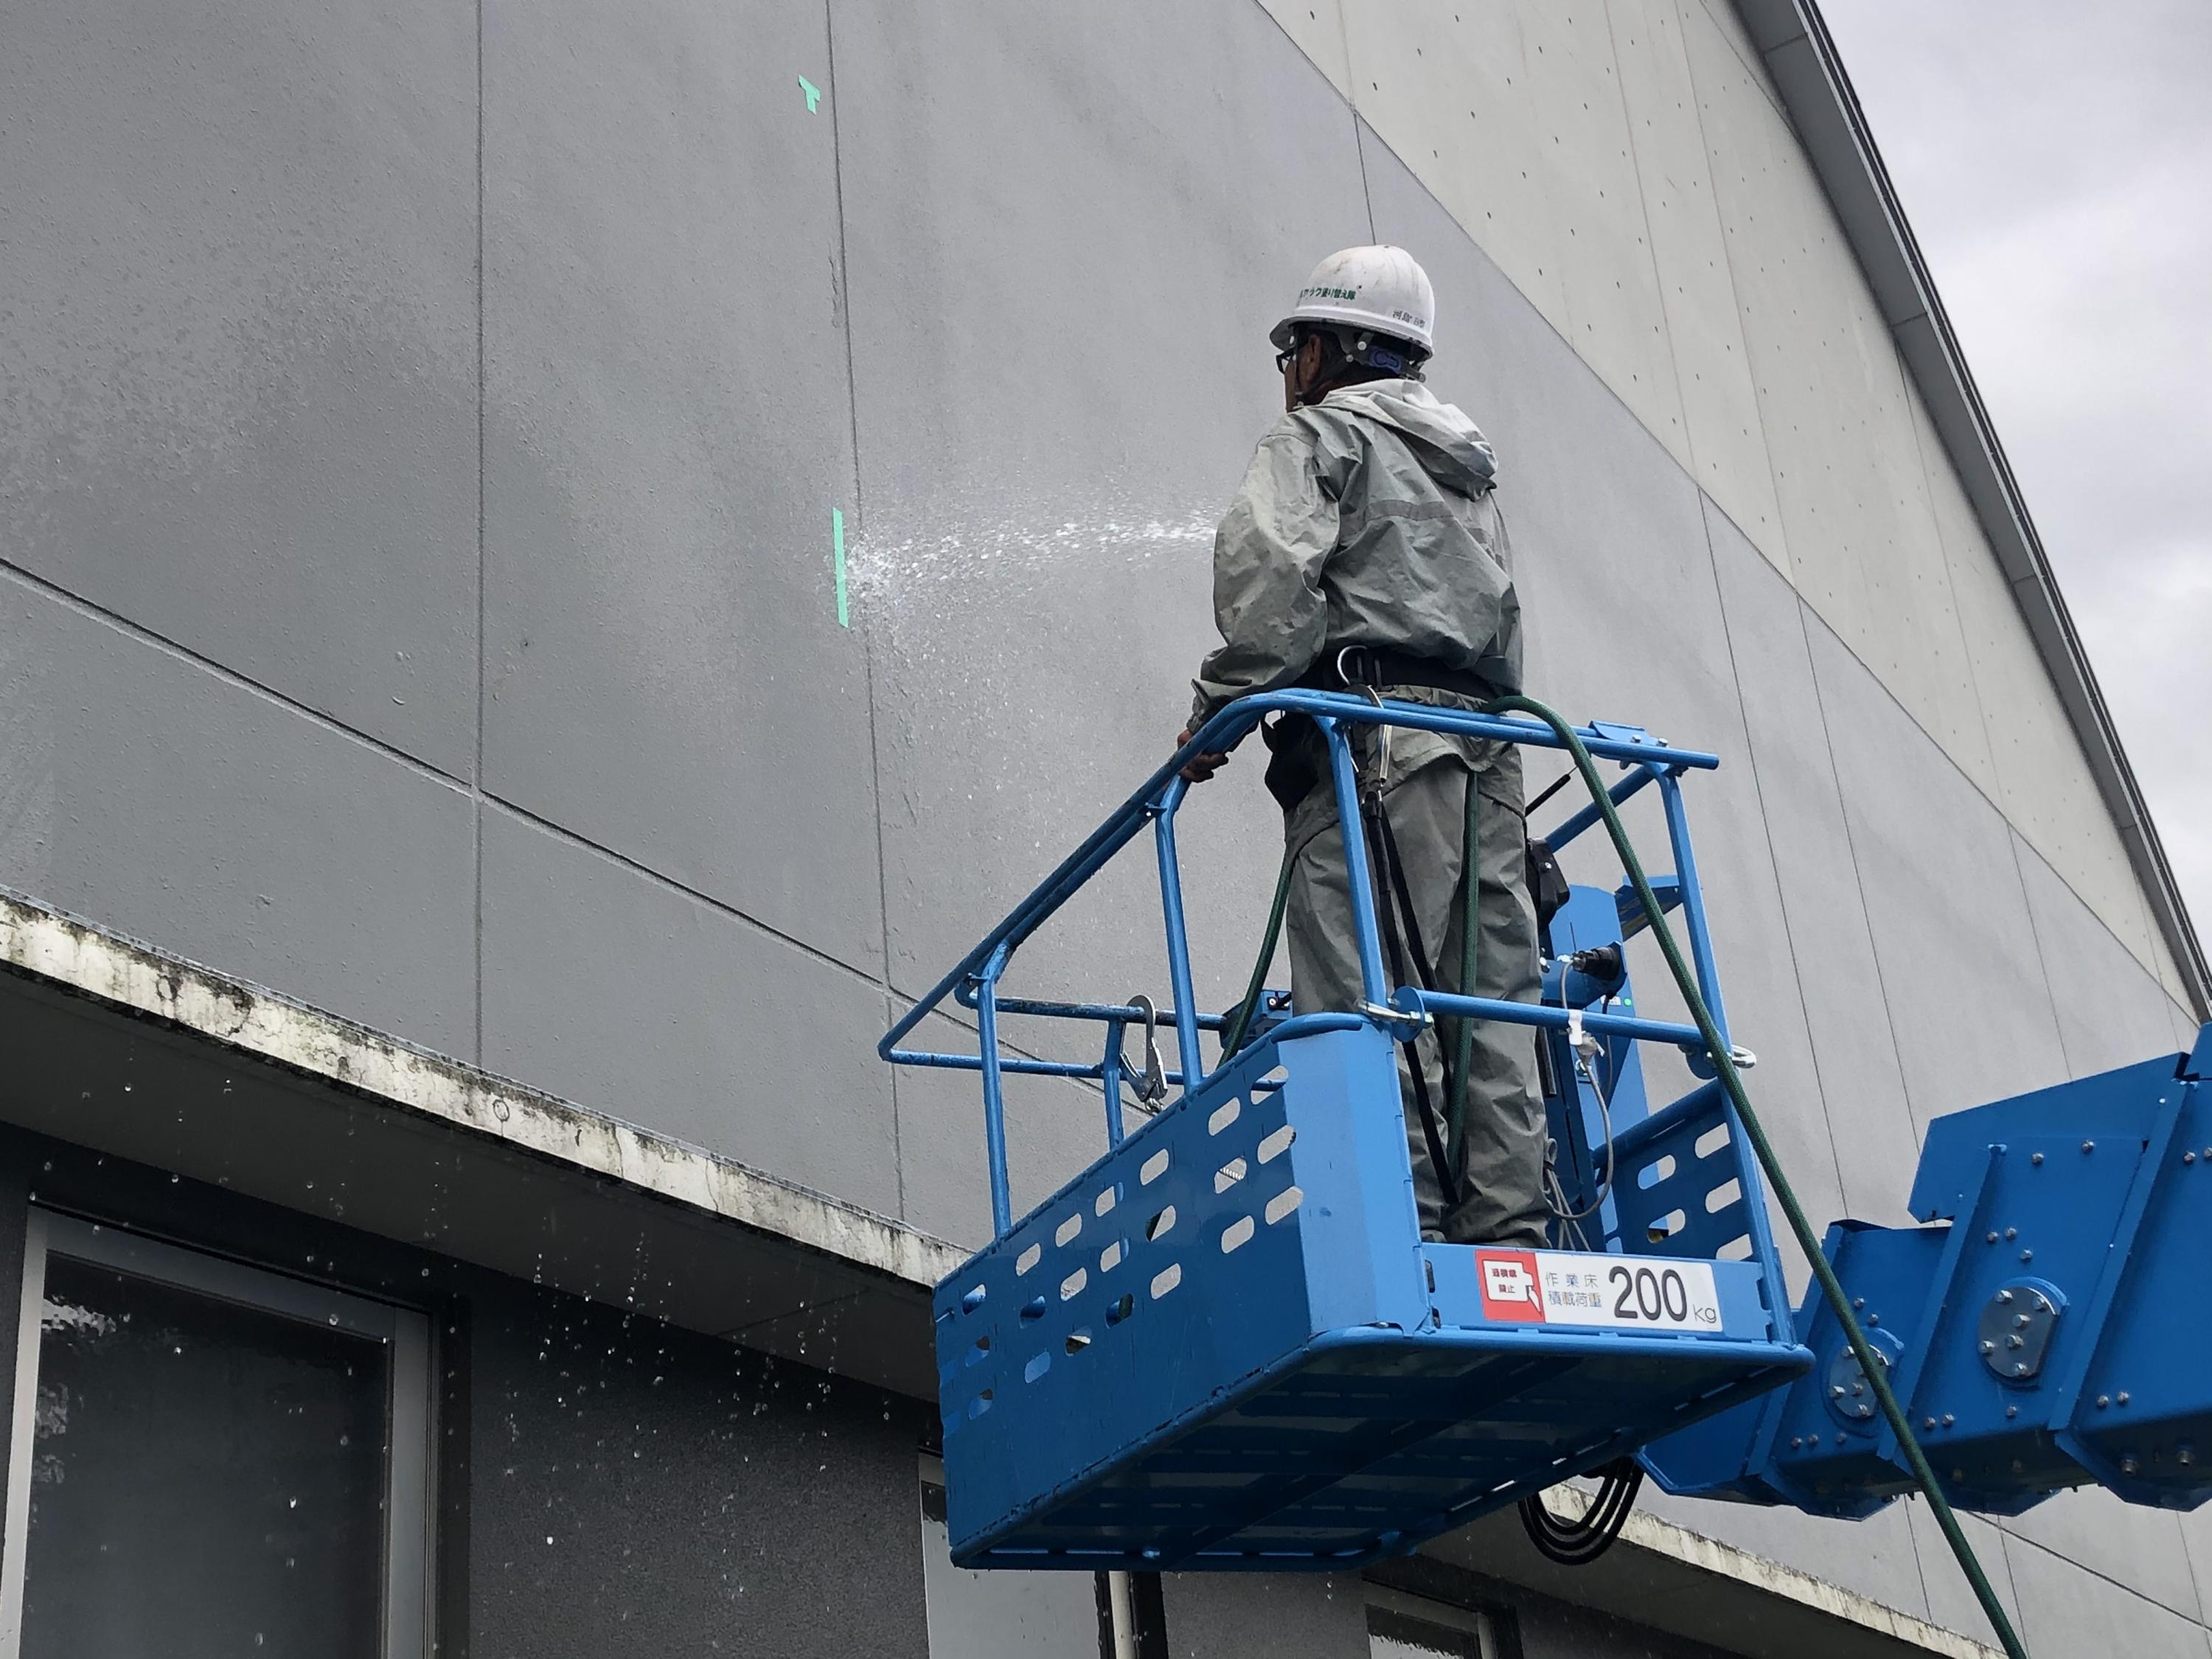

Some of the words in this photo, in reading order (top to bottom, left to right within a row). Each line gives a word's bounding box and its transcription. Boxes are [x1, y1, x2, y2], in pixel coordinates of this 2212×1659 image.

[1545, 1272, 1599, 1289] 作業床
[1548, 1290, 1603, 1309] 積載荷重
